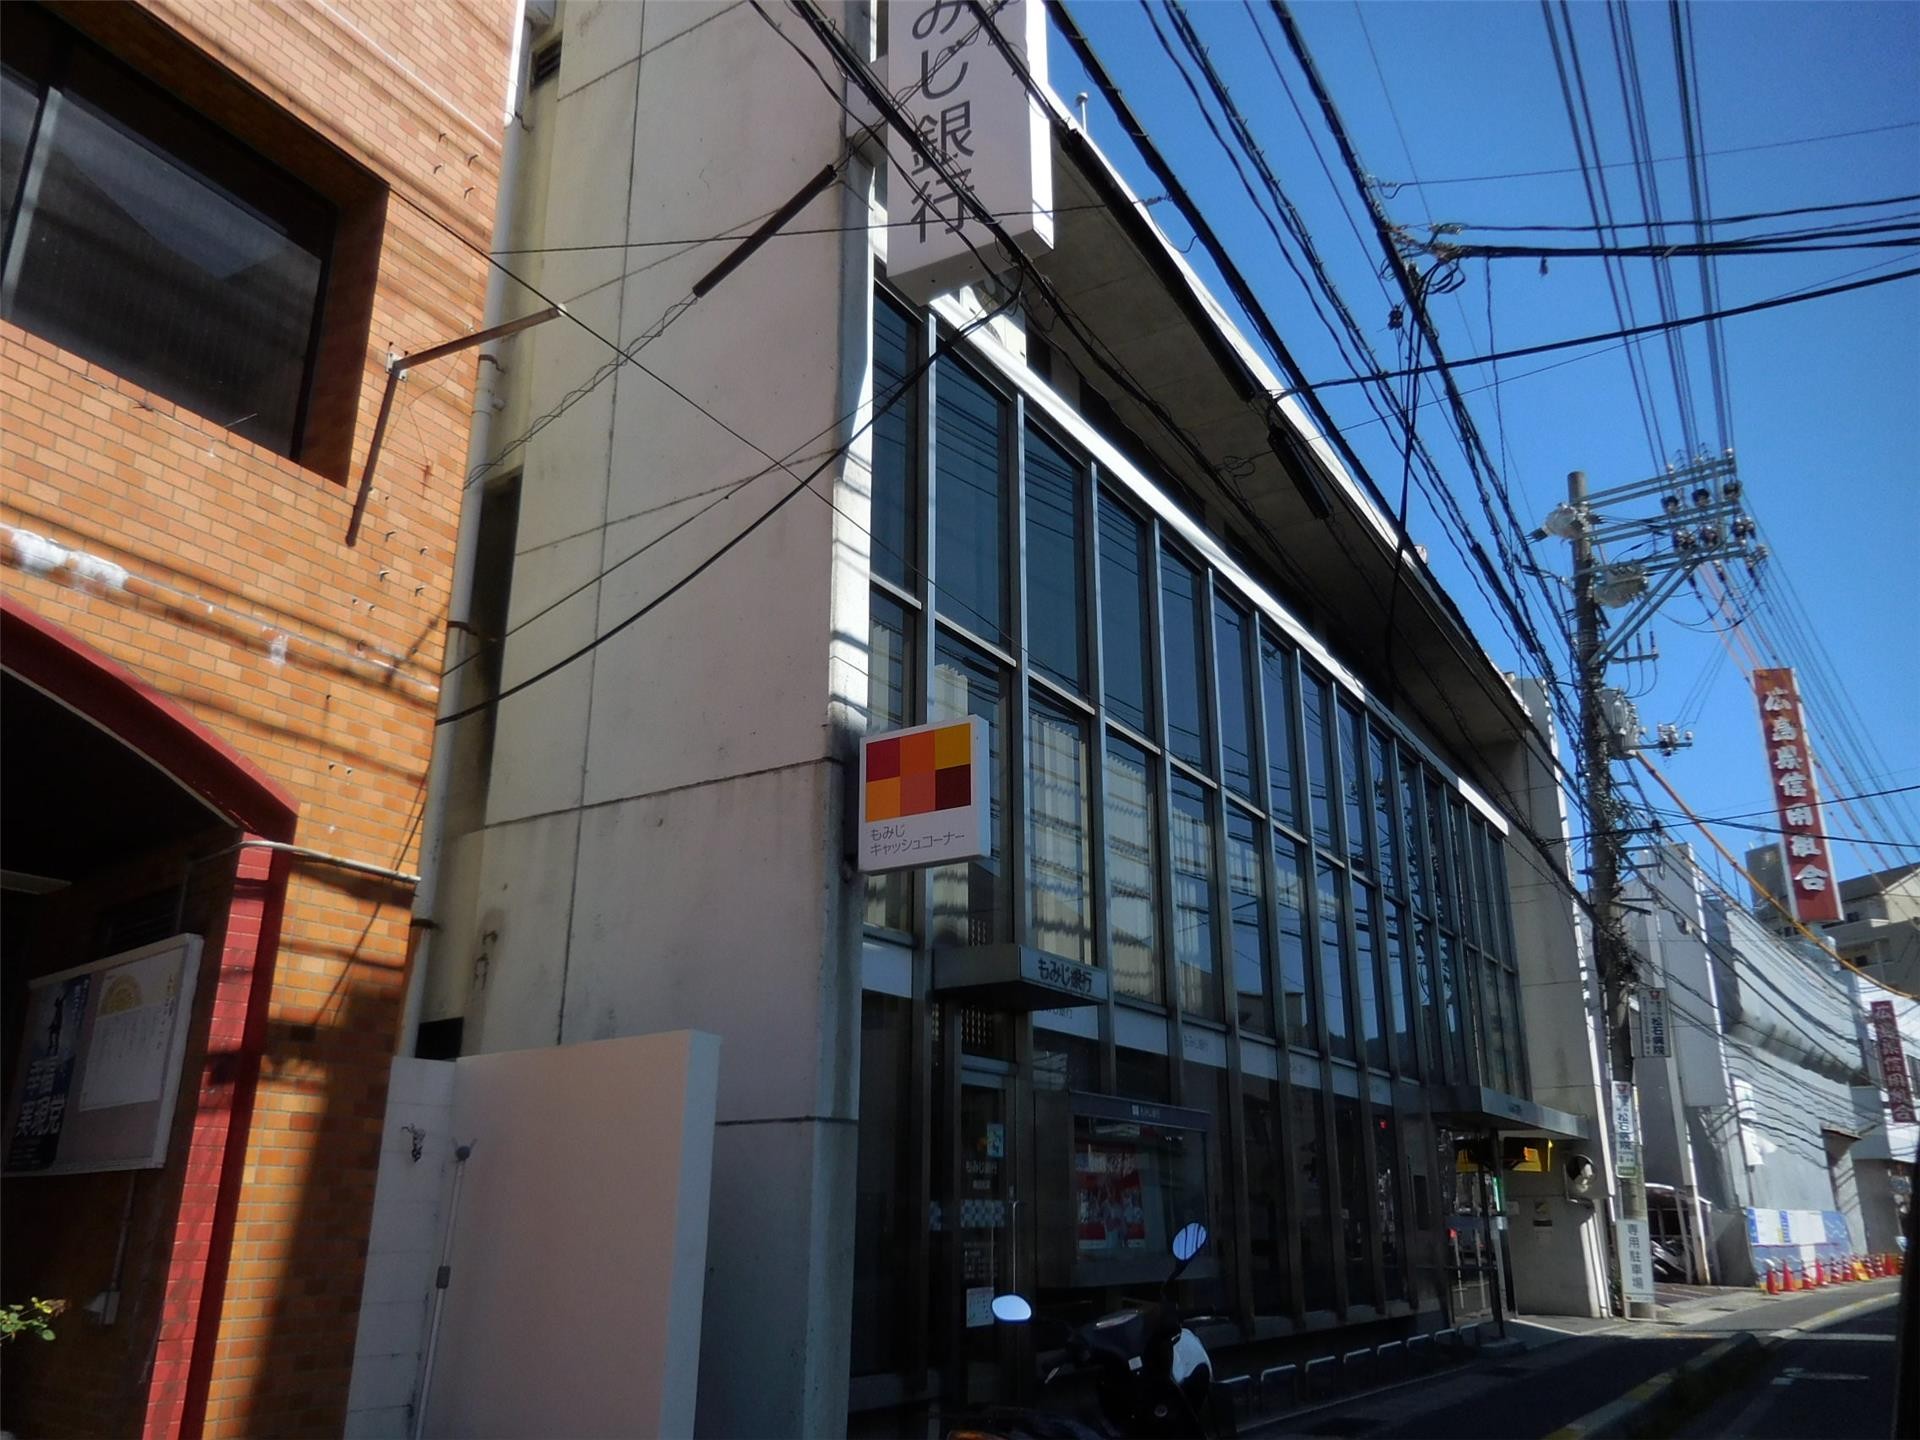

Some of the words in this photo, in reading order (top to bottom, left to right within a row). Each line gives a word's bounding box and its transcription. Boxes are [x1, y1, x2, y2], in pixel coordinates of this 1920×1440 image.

[1763, 687, 1829, 893] 広島県信用組合
[870, 824, 905, 842] もみじ
[870, 831, 965, 857] キャッシュコーナー
[1038, 958, 1092, 992] もみじ銀行
[1627, 1224, 1645, 1290] 専用駐車場
